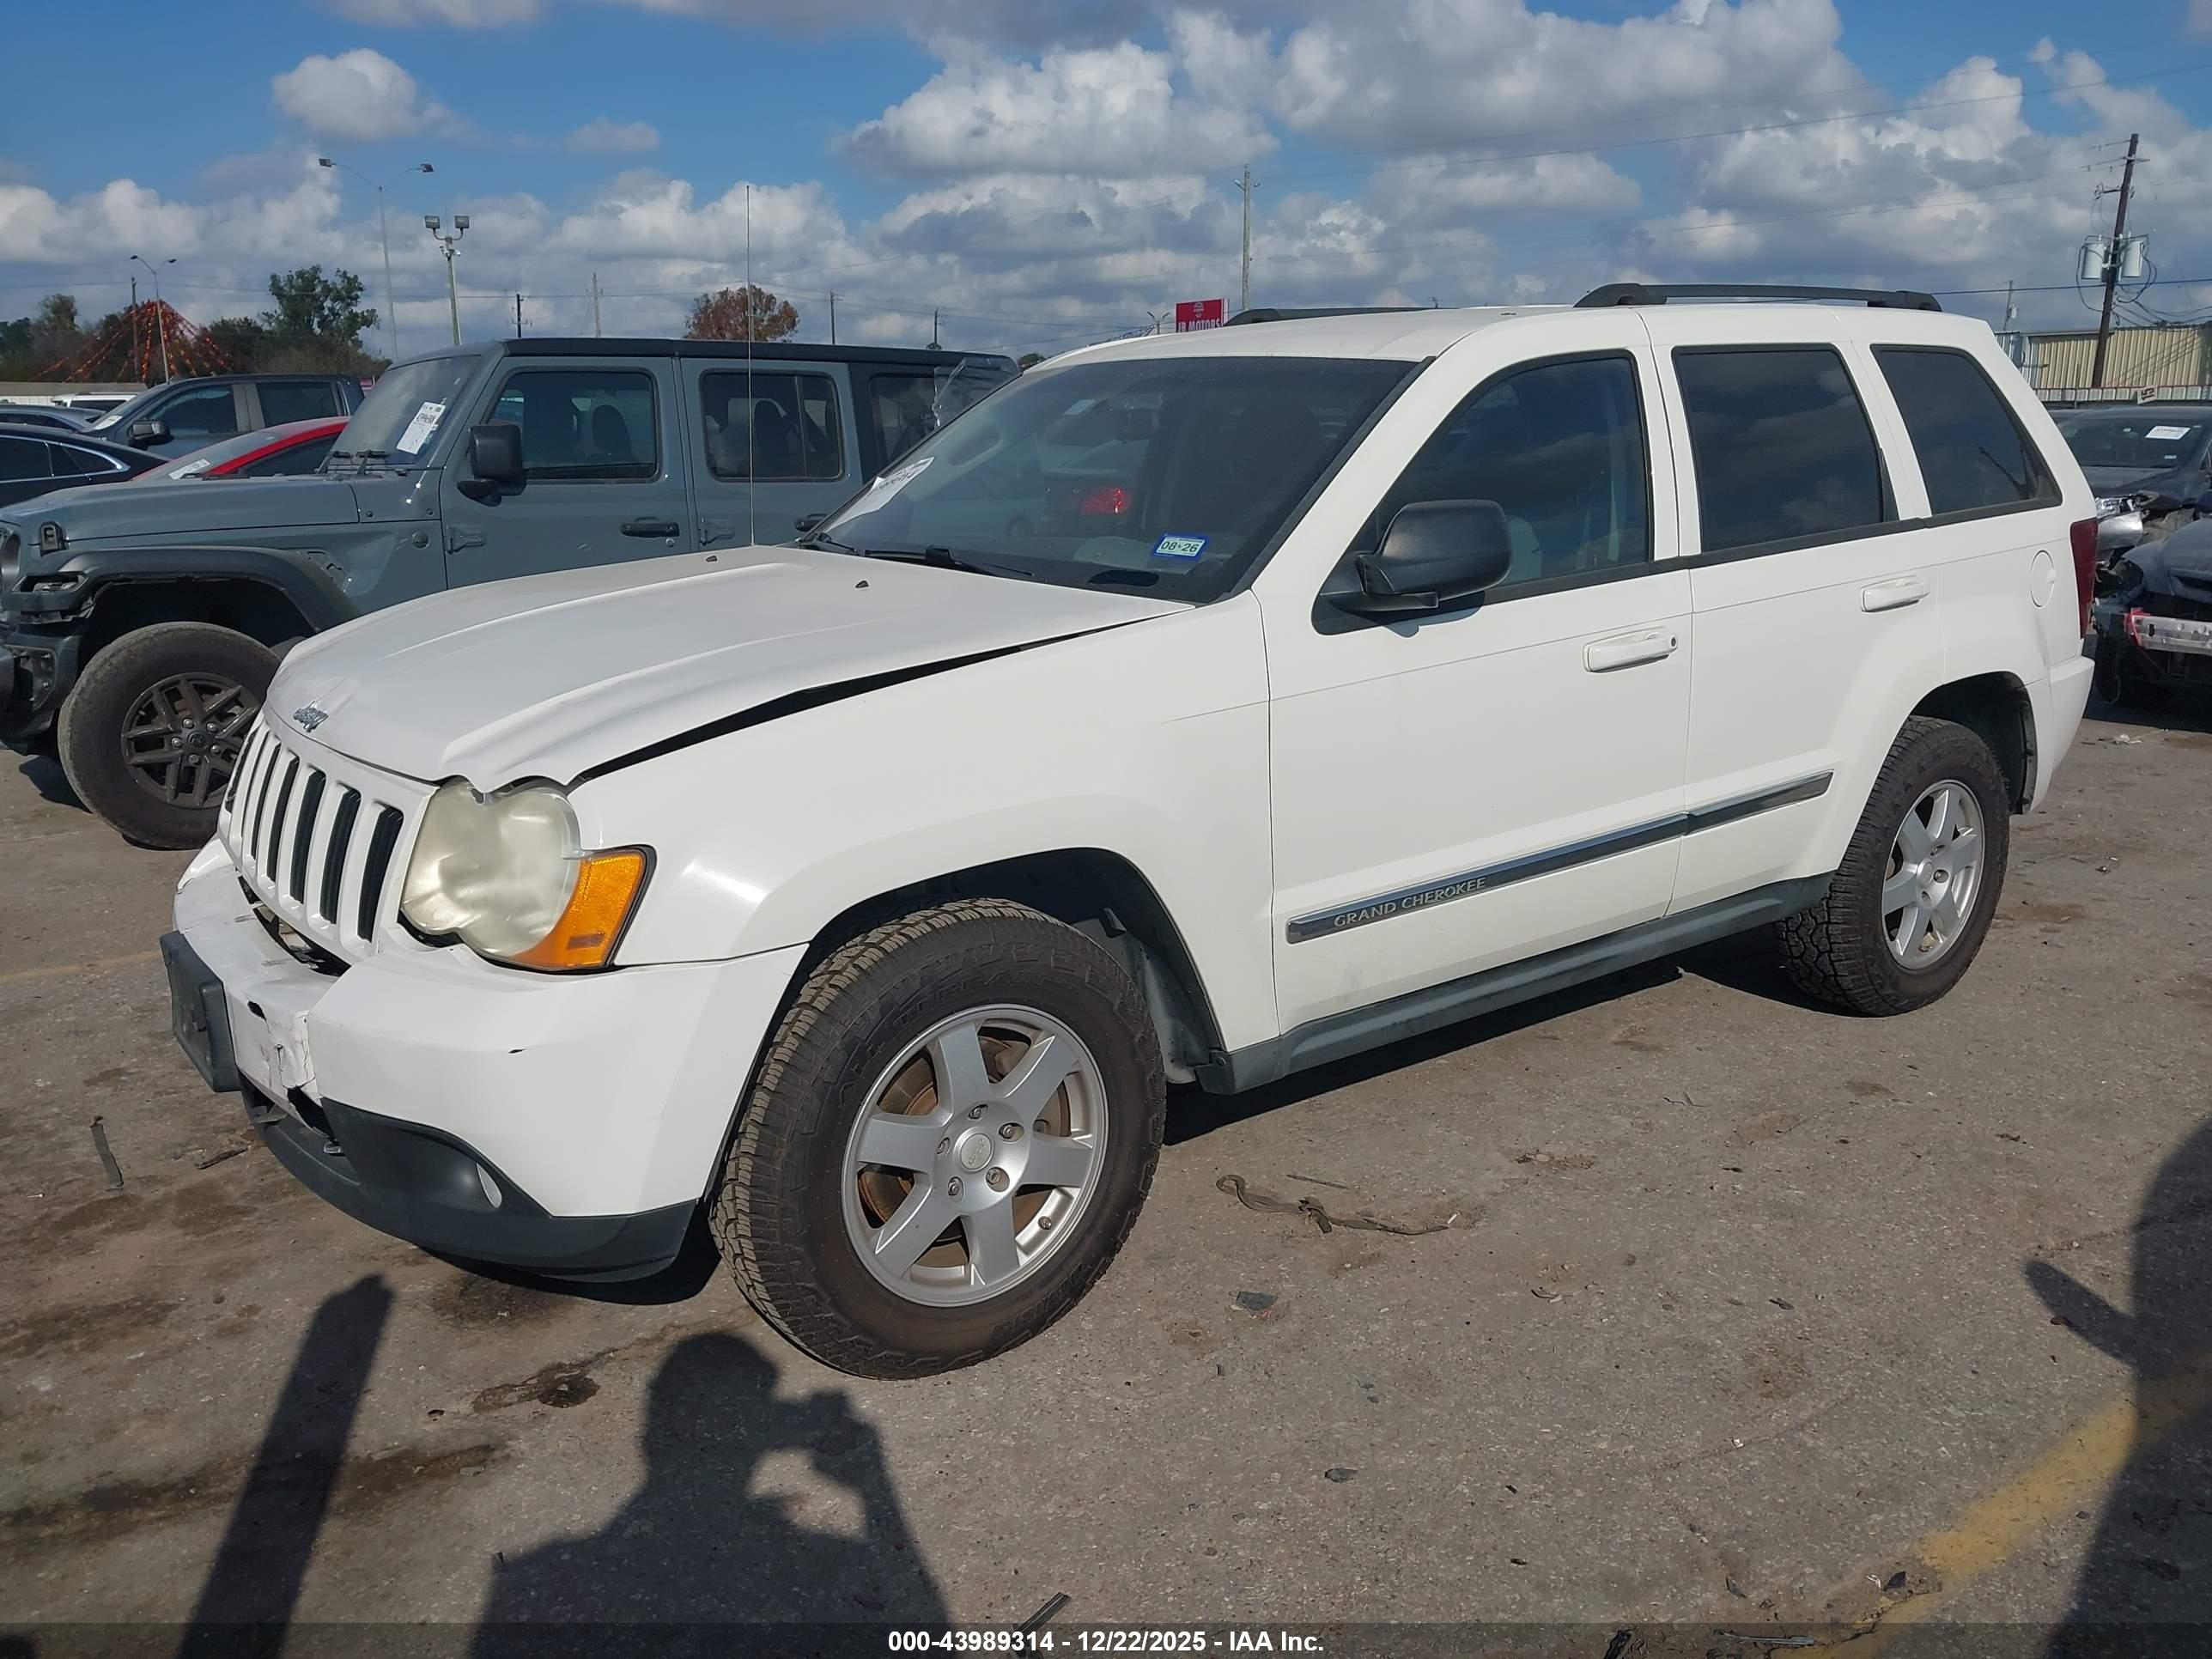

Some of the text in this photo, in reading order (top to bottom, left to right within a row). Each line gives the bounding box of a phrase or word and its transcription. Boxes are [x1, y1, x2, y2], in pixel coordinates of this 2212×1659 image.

[1188, 318, 1220, 331] MOTORS
[1334, 877, 1486, 928] GRAND CHEROKEE
